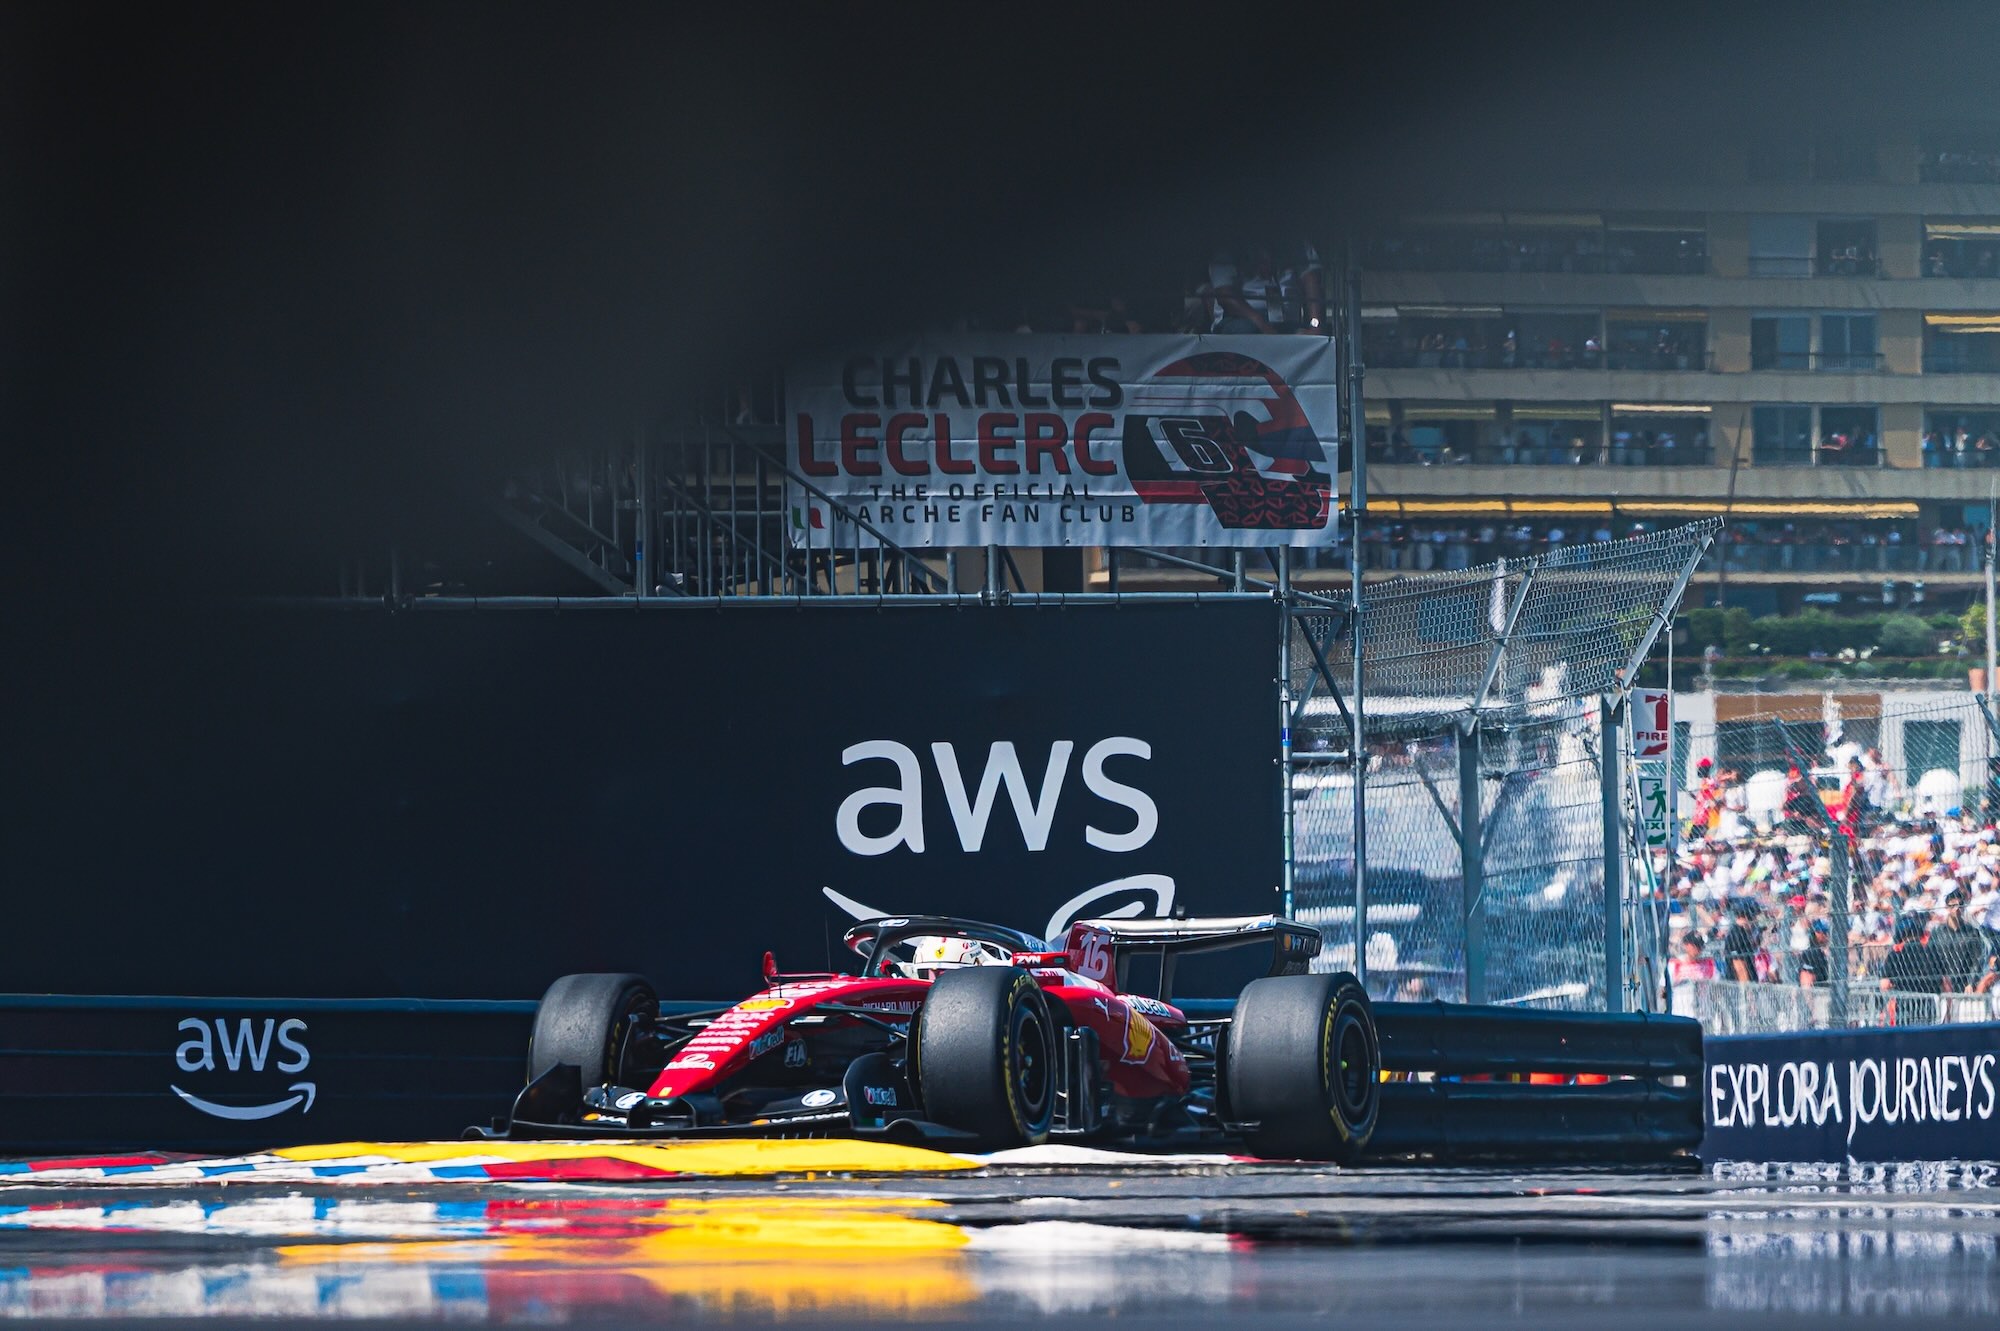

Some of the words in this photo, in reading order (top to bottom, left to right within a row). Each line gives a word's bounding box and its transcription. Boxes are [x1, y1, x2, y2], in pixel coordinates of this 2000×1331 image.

[841, 356, 1124, 411] CHARLES
[797, 412, 1118, 477] LECLERC
[834, 505, 961, 524] MARCHE
[982, 505, 1039, 523] FAN
[1060, 504, 1135, 523] CLUB
[869, 484, 928, 502] THE
[949, 483, 1095, 501] OFFICIAL
[1636, 731, 1669, 741] FIRE
[836, 736, 1159, 856] aws
[1077, 931, 1110, 981] 16
[176, 1017, 311, 1073] aws
[1710, 1061, 1843, 1128] EXPLORA
[1846, 1053, 1996, 1146] JOURNEYS
